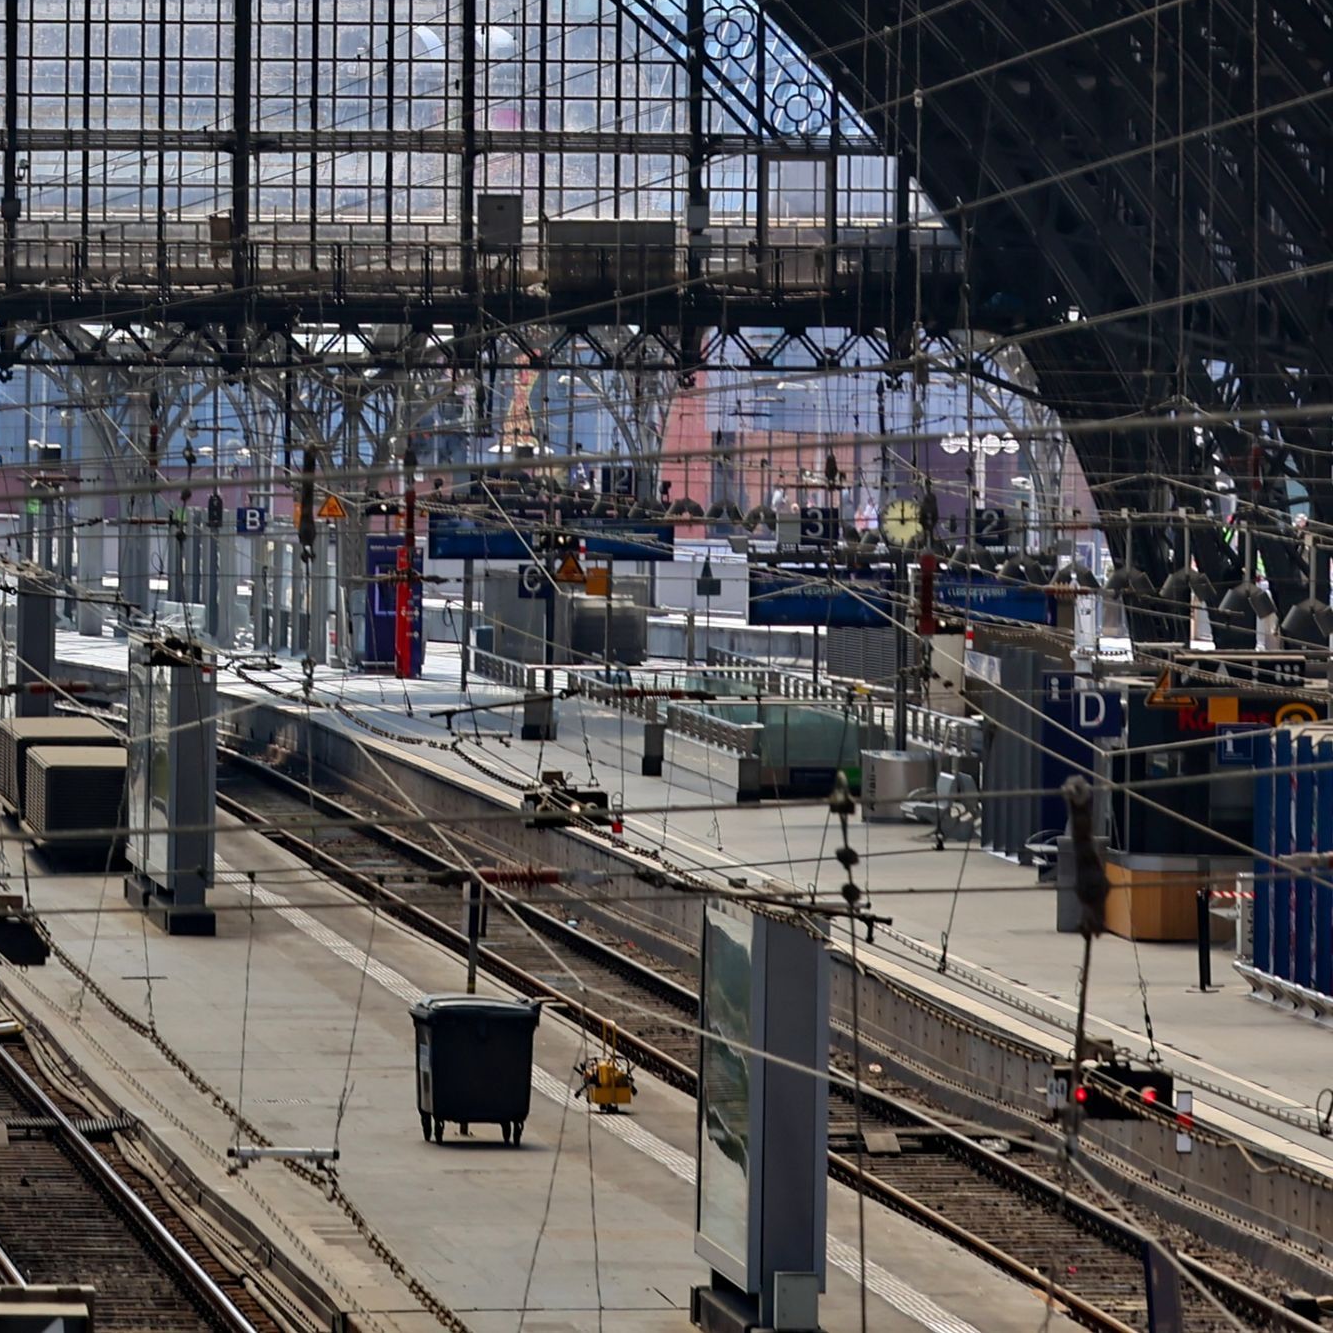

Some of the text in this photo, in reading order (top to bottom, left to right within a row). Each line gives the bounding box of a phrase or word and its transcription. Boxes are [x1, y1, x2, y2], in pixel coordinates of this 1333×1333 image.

[246, 510, 260, 530] B
[805, 508, 824, 537] 3
[982, 508, 1001, 538] 2
[523, 565, 542, 592] C
[1079, 691, 1106, 728] D
